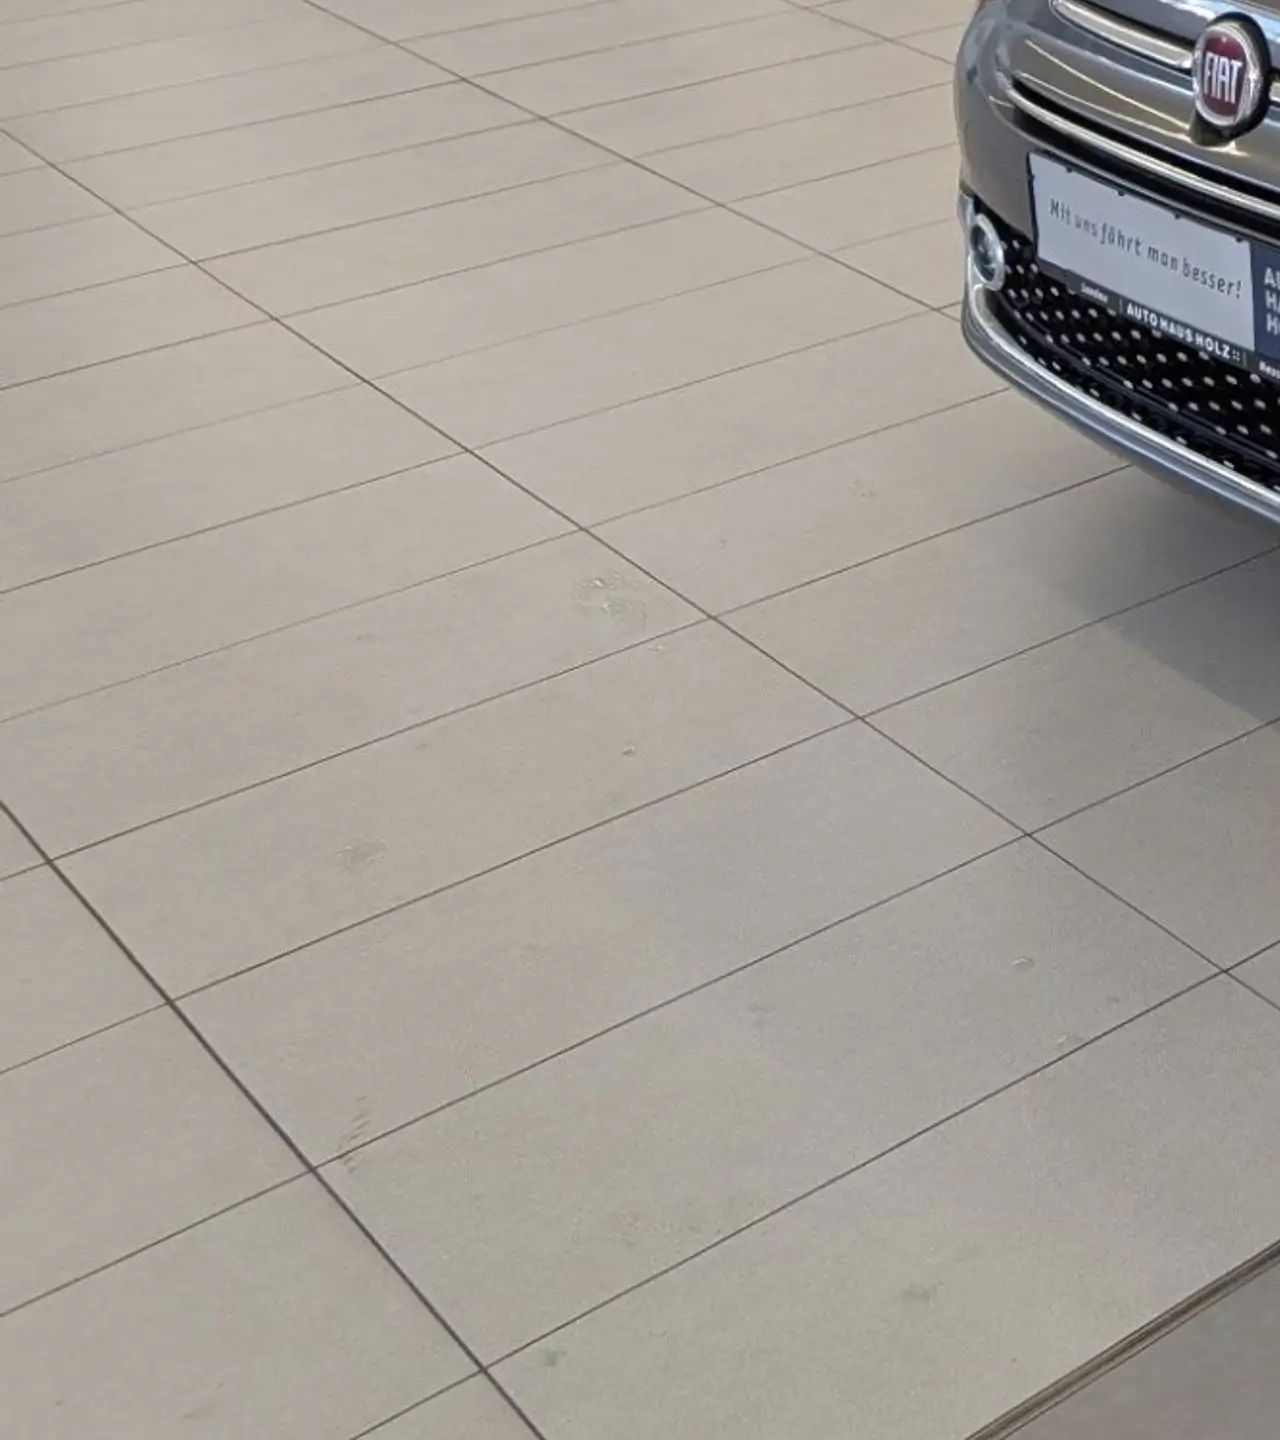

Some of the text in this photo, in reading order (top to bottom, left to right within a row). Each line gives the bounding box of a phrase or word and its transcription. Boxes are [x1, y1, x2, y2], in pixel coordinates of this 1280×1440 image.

[1204, 51, 1243, 104] FIAT
[1049, 198, 1242, 299] Mit uns fährt man besser!
[1195, 333, 1230, 359] HOLZ
